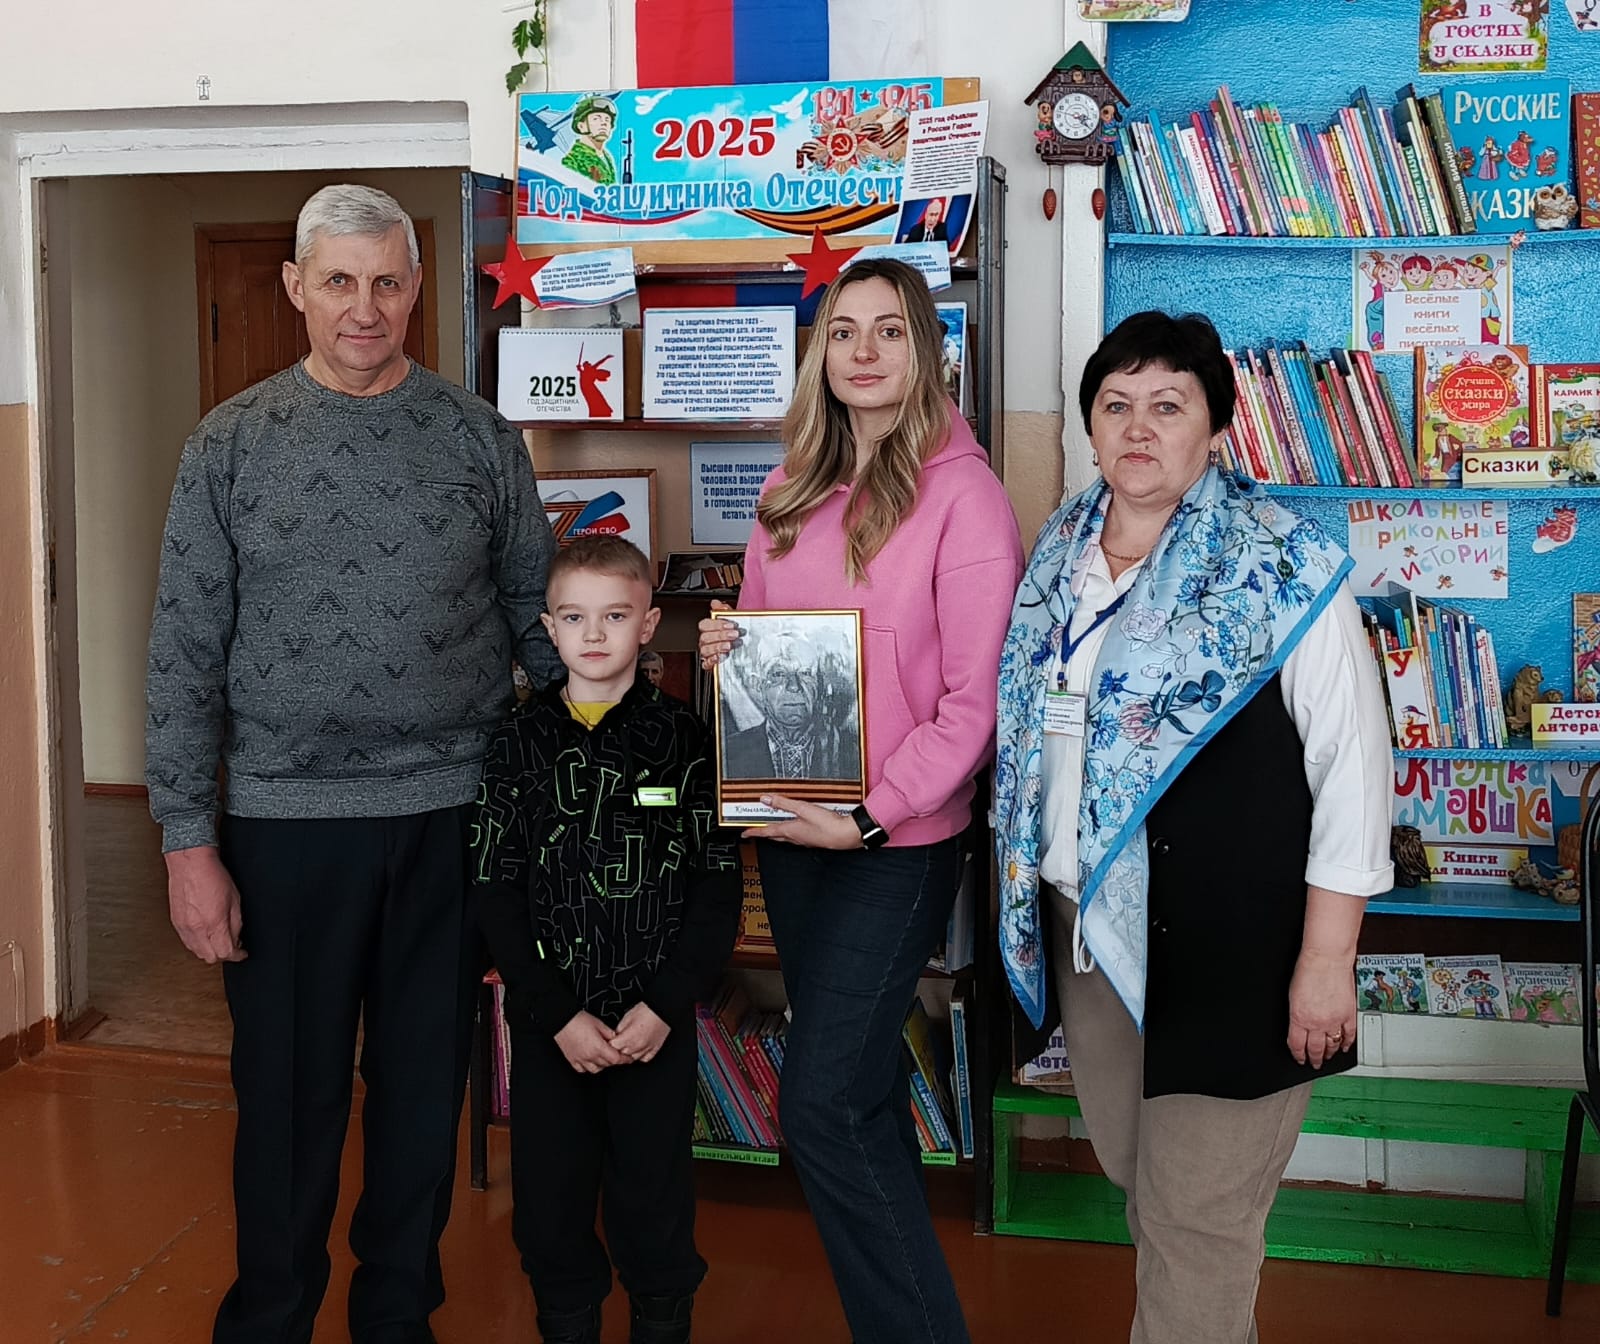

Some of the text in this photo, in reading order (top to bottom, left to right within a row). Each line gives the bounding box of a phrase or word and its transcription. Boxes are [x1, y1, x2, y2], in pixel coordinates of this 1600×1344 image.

[1480, 4, 1492, 17] В
[1445, 24, 1523, 38] ГОСТЯХ
[1434, 44, 1534, 58] У СКАЗКИ
[655, 117, 776, 159] 2025
[528, 180, 583, 220] Год
[593, 181, 754, 218] защитника
[1405, 293, 1460, 304] Весёлые
[1414, 310, 1450, 319] книги
[529, 375, 576, 397] 2025
[701, 463, 733, 473] Высшее
[1464, 457, 1539, 473] Сказки
[700, 475, 737, 484] человека
[722, 511, 747, 519] встать
[573, 526, 617, 536] ГЕРОИ СВО
[1401, 544, 1504, 581] ИСТОРИИ
[1443, 851, 1498, 864] Книги
